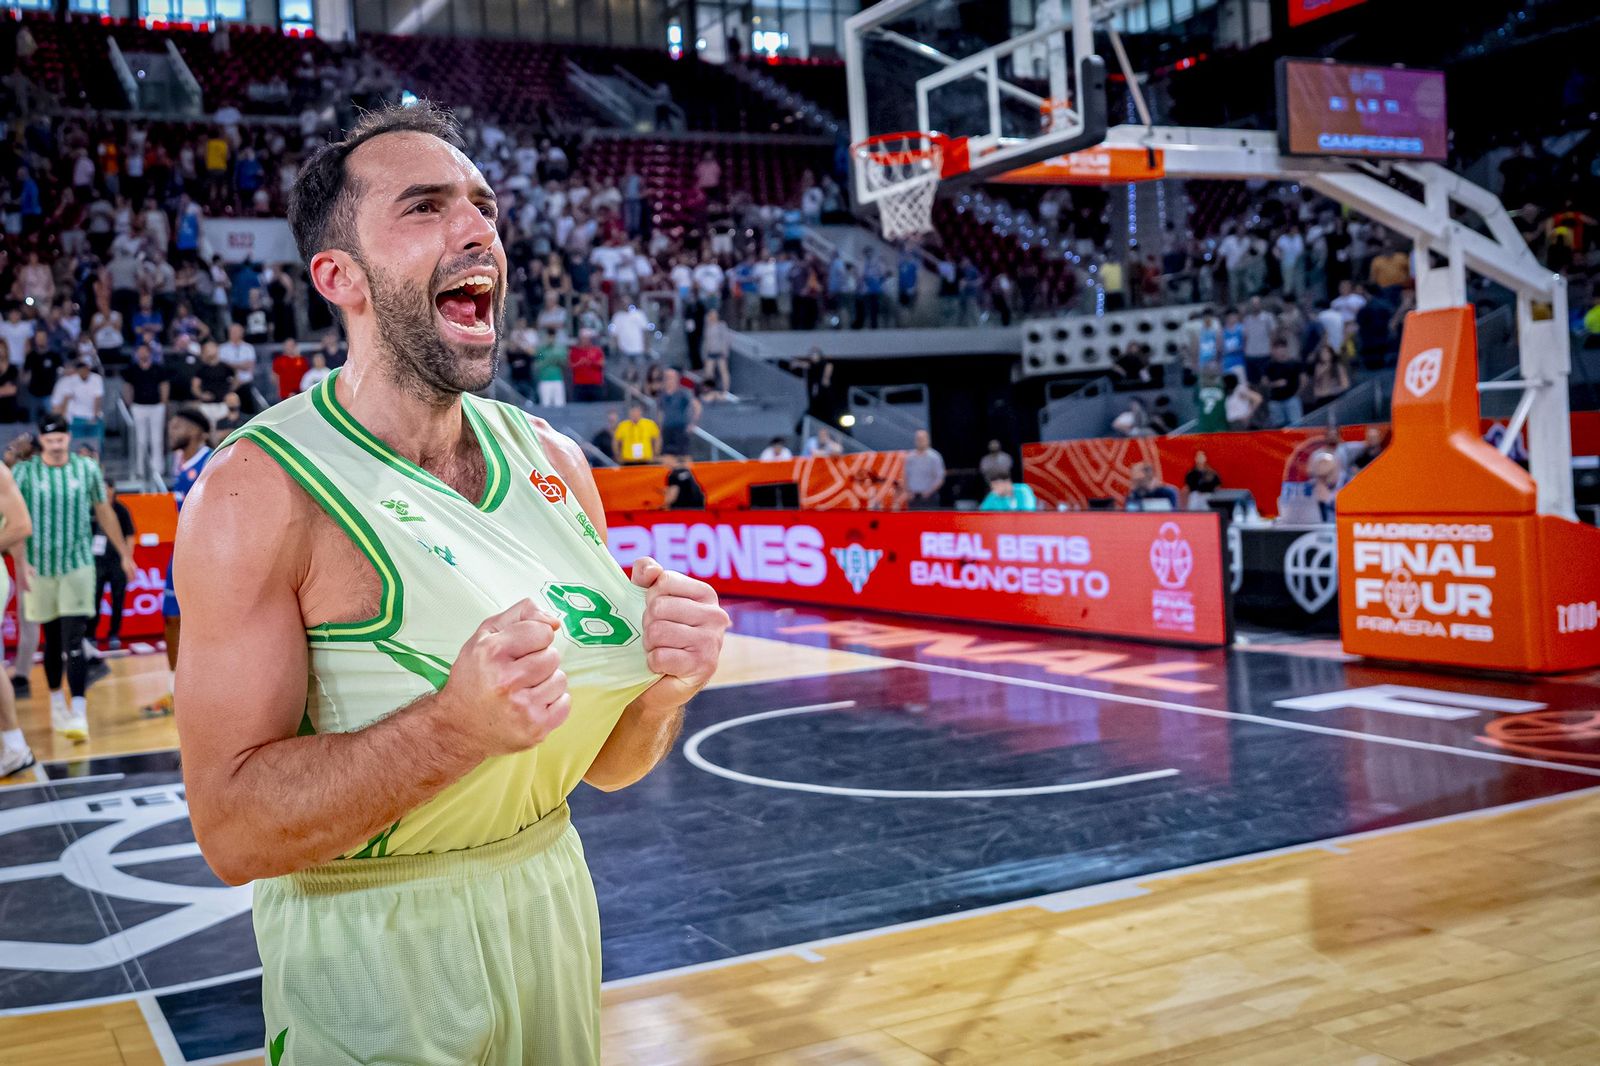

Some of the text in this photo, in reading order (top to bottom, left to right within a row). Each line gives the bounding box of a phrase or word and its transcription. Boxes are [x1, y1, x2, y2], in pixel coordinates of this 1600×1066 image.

[920, 531, 1091, 565] REAL BETIS
[1354, 541, 1496, 578] FINAL
[909, 561, 1110, 598] BALONCESTO
[541, 581, 640, 648] 8
[1356, 615, 1494, 642] PRIMERA FEB
[87, 790, 187, 812] FE
